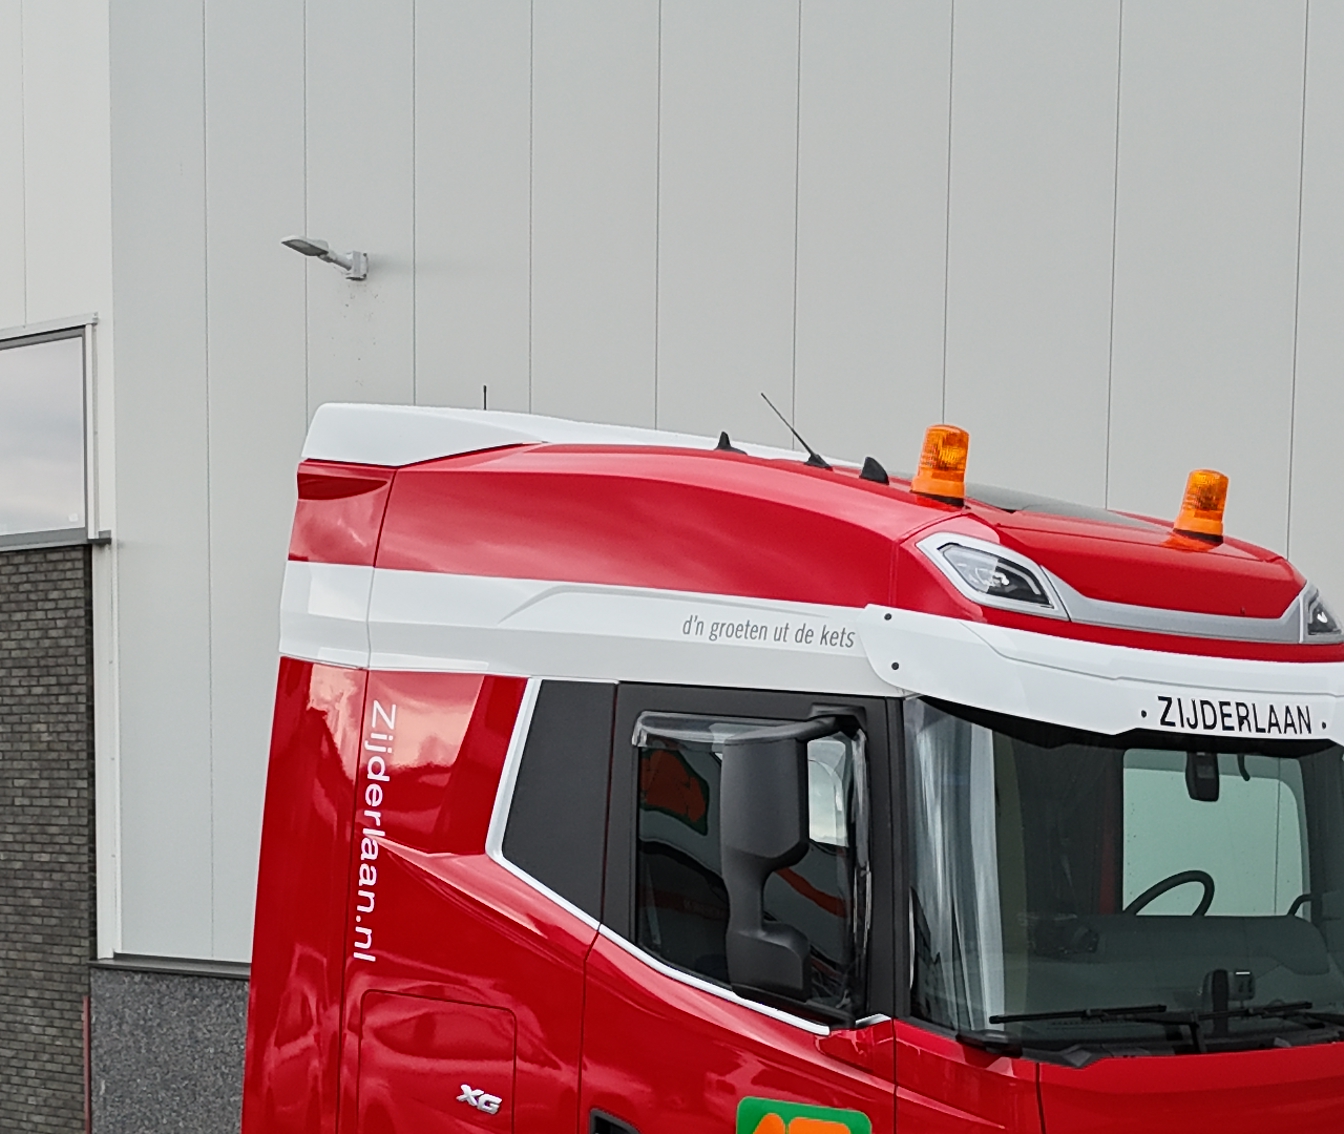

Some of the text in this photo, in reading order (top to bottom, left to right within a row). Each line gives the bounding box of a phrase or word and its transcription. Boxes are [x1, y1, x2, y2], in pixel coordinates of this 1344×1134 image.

[709, 619, 768, 642] groeten
[773, 622, 790, 643] ut
[794, 622, 814, 645] de
[819, 624, 856, 649] kets
[1157, 695, 1312, 734] ZIJDERLAAN
[353, 699, 397, 963] Zijderlaan.nl
[456, 1083, 503, 1115] XG
